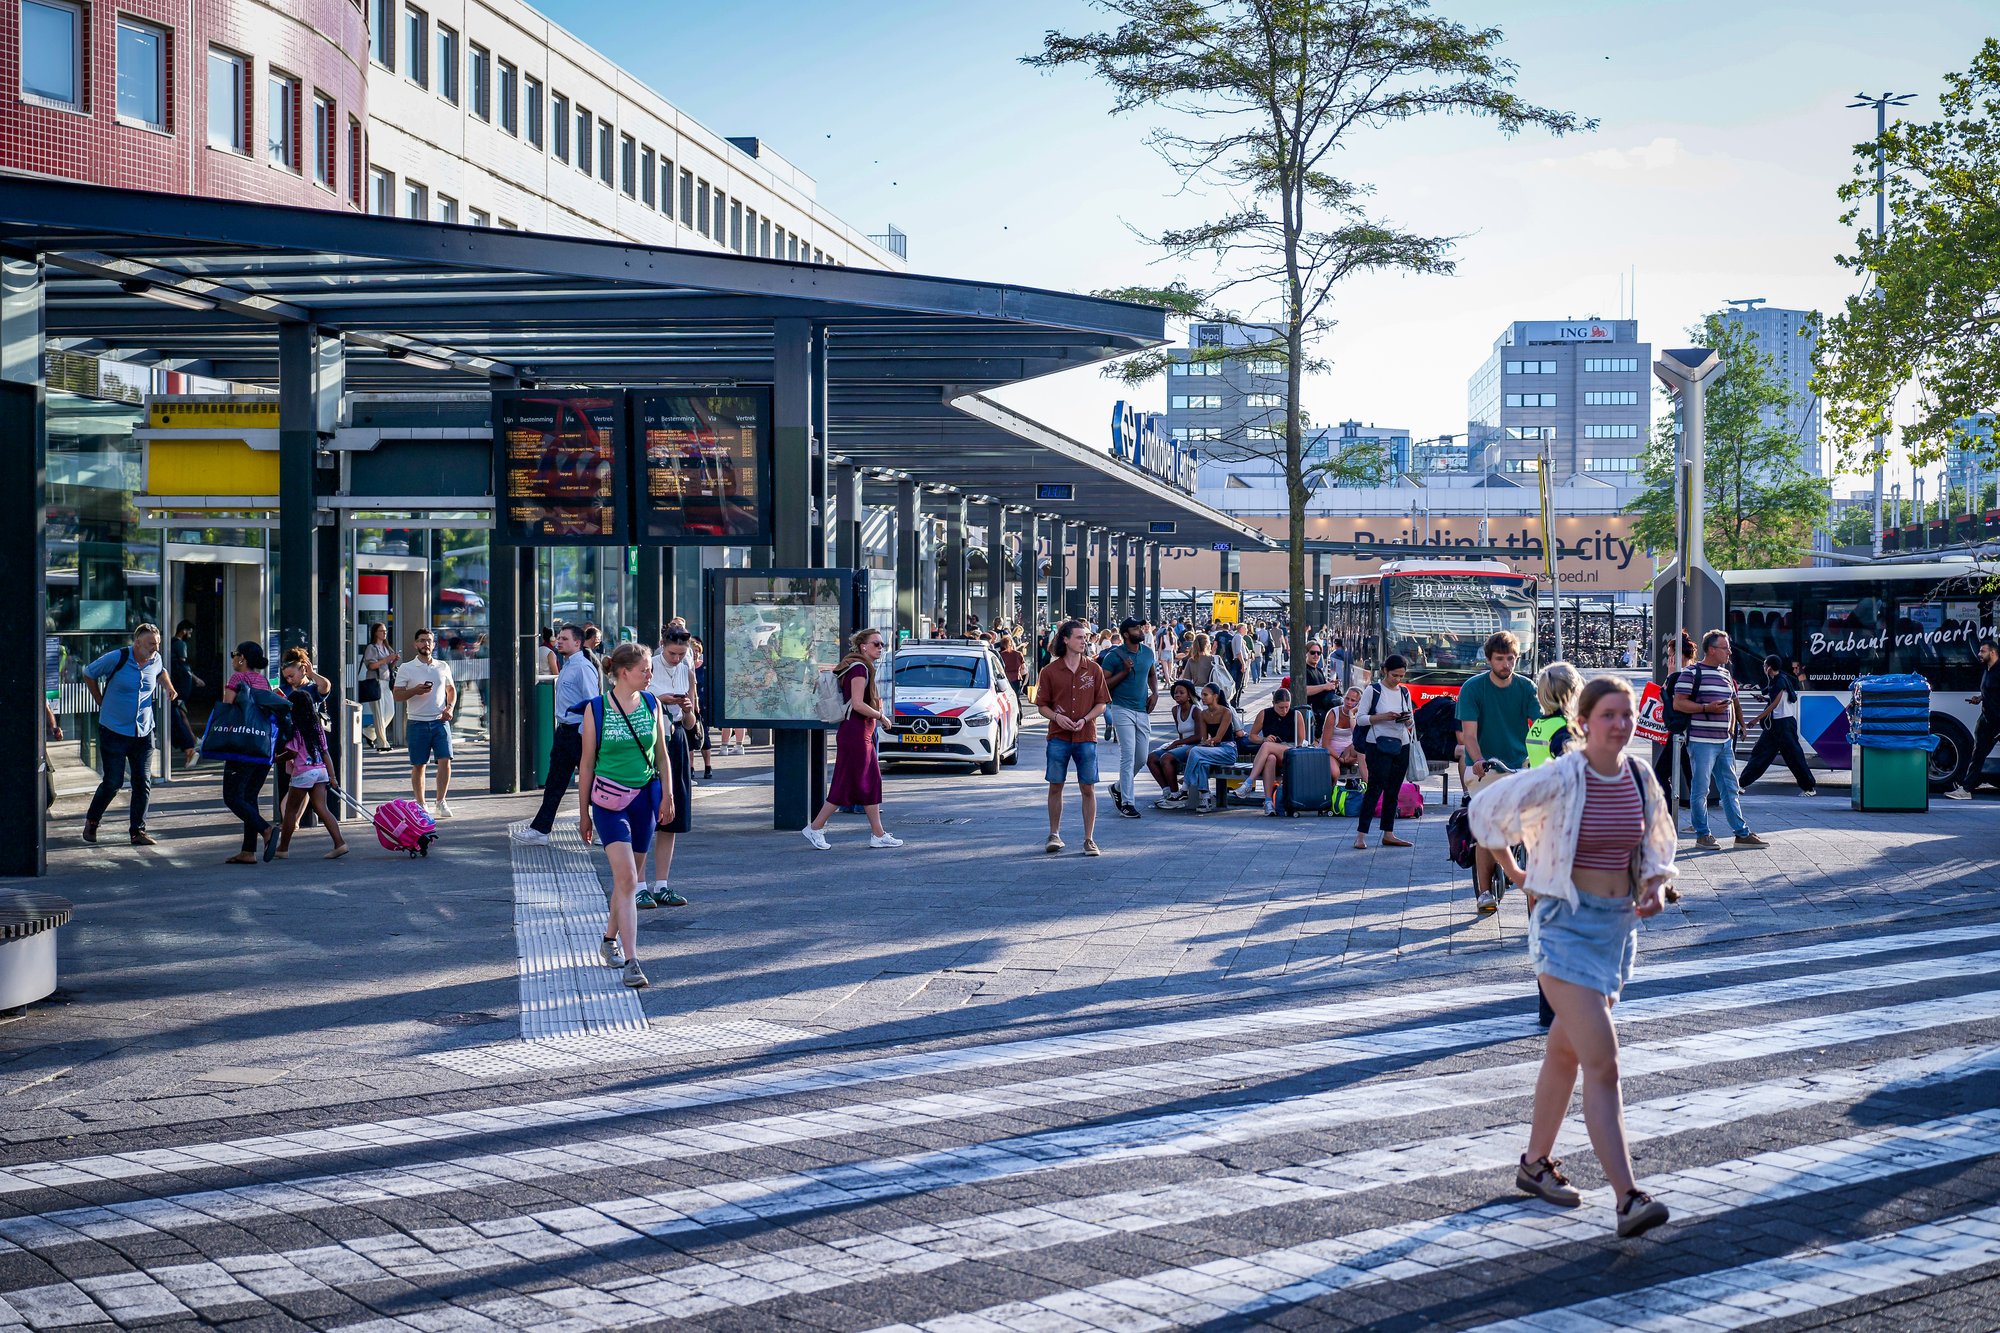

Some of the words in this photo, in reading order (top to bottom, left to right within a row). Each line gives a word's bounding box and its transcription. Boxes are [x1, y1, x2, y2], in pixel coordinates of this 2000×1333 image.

[1560, 328, 1588, 338] ING
[1576, 530, 1635, 570] city
[1412, 583, 1432, 598] 318
[1809, 629, 1889, 655] Brabant
[1895, 620, 1973, 647] vervoert
[1978, 626, 2000, 639] on
